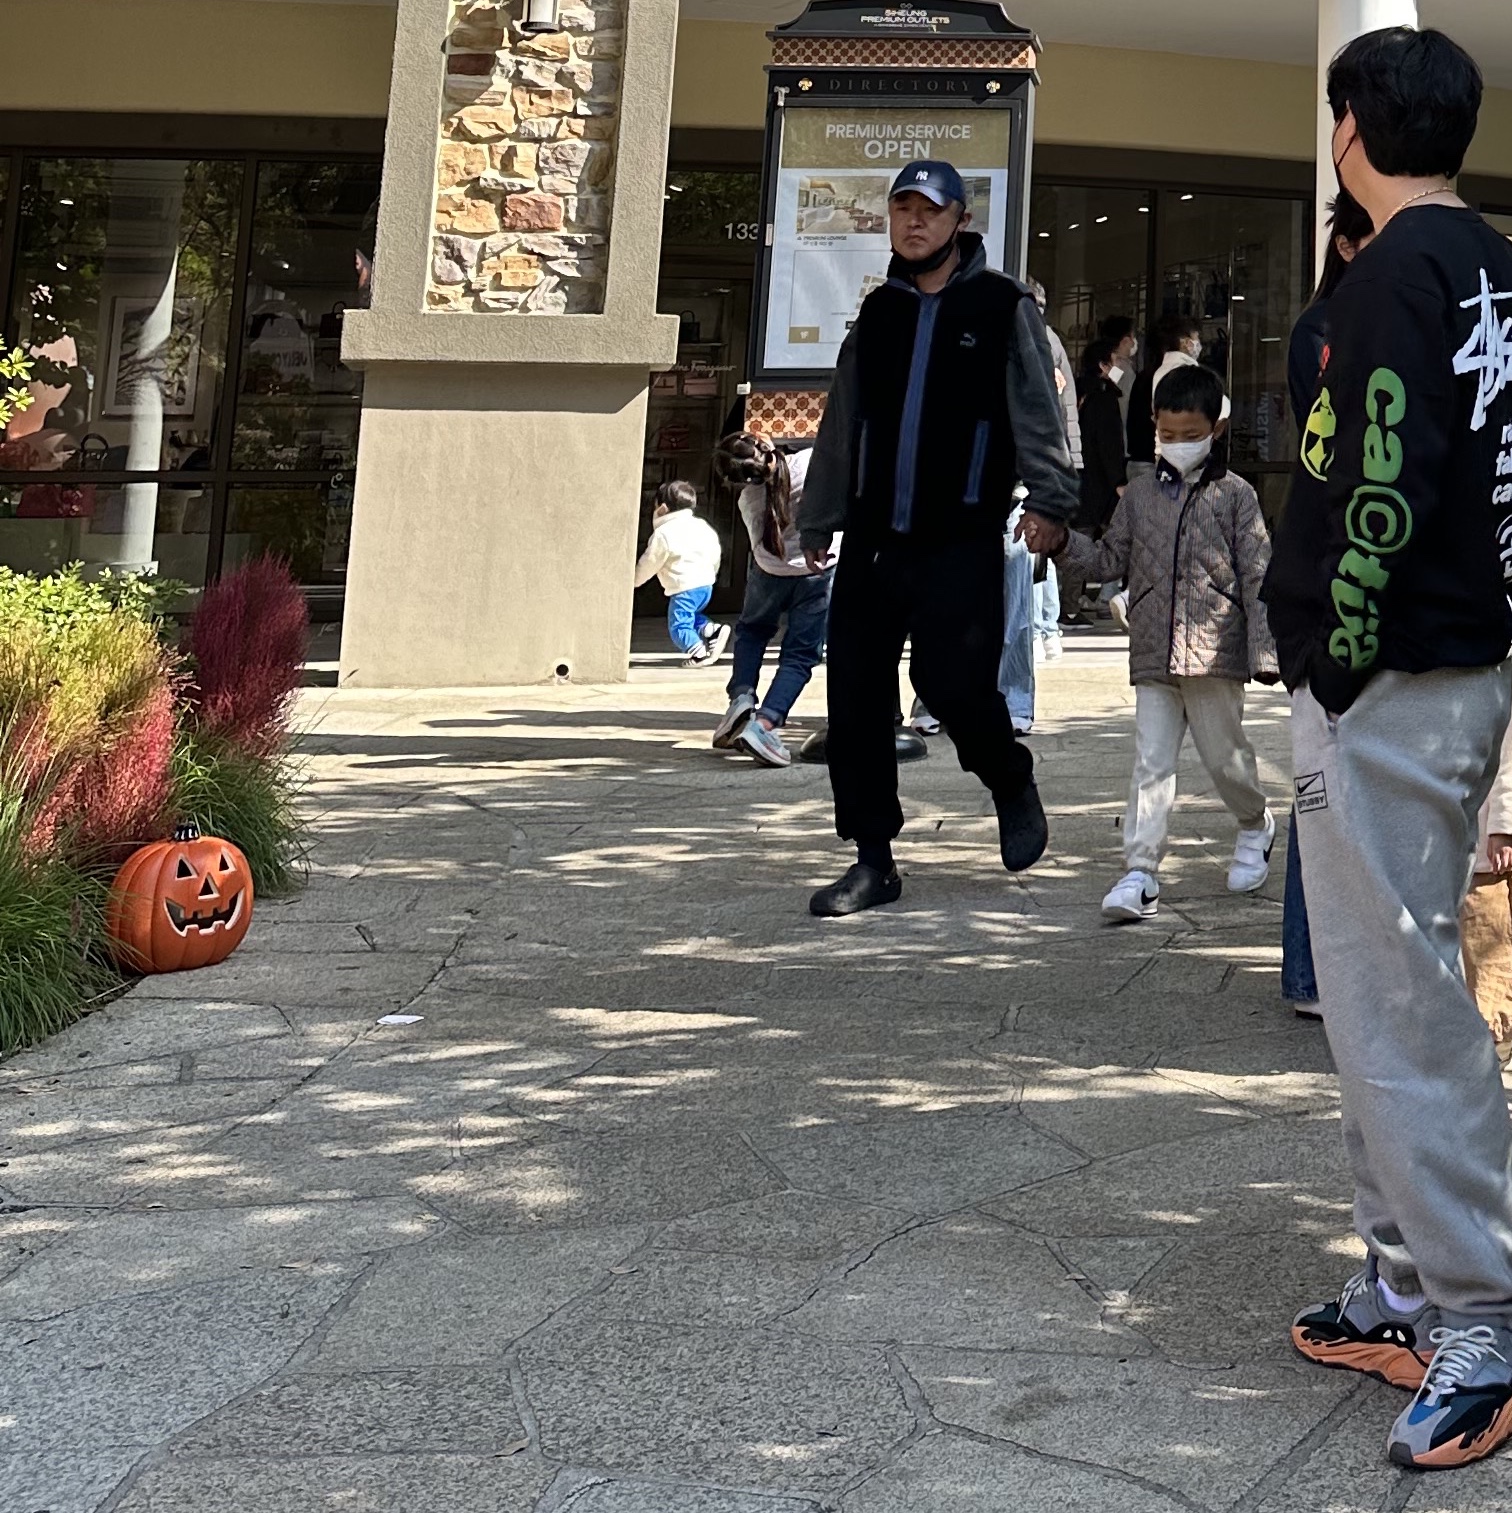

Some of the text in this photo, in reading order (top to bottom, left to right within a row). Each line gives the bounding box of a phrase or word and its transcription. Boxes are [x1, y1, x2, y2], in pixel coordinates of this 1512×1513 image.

[860, 15, 951, 24] PREMIUM OUTLETS
[829, 78, 971, 92] DIRECTORY
[825, 123, 972, 139] PREMIUM SERVICE
[863, 139, 931, 159] OPEN
